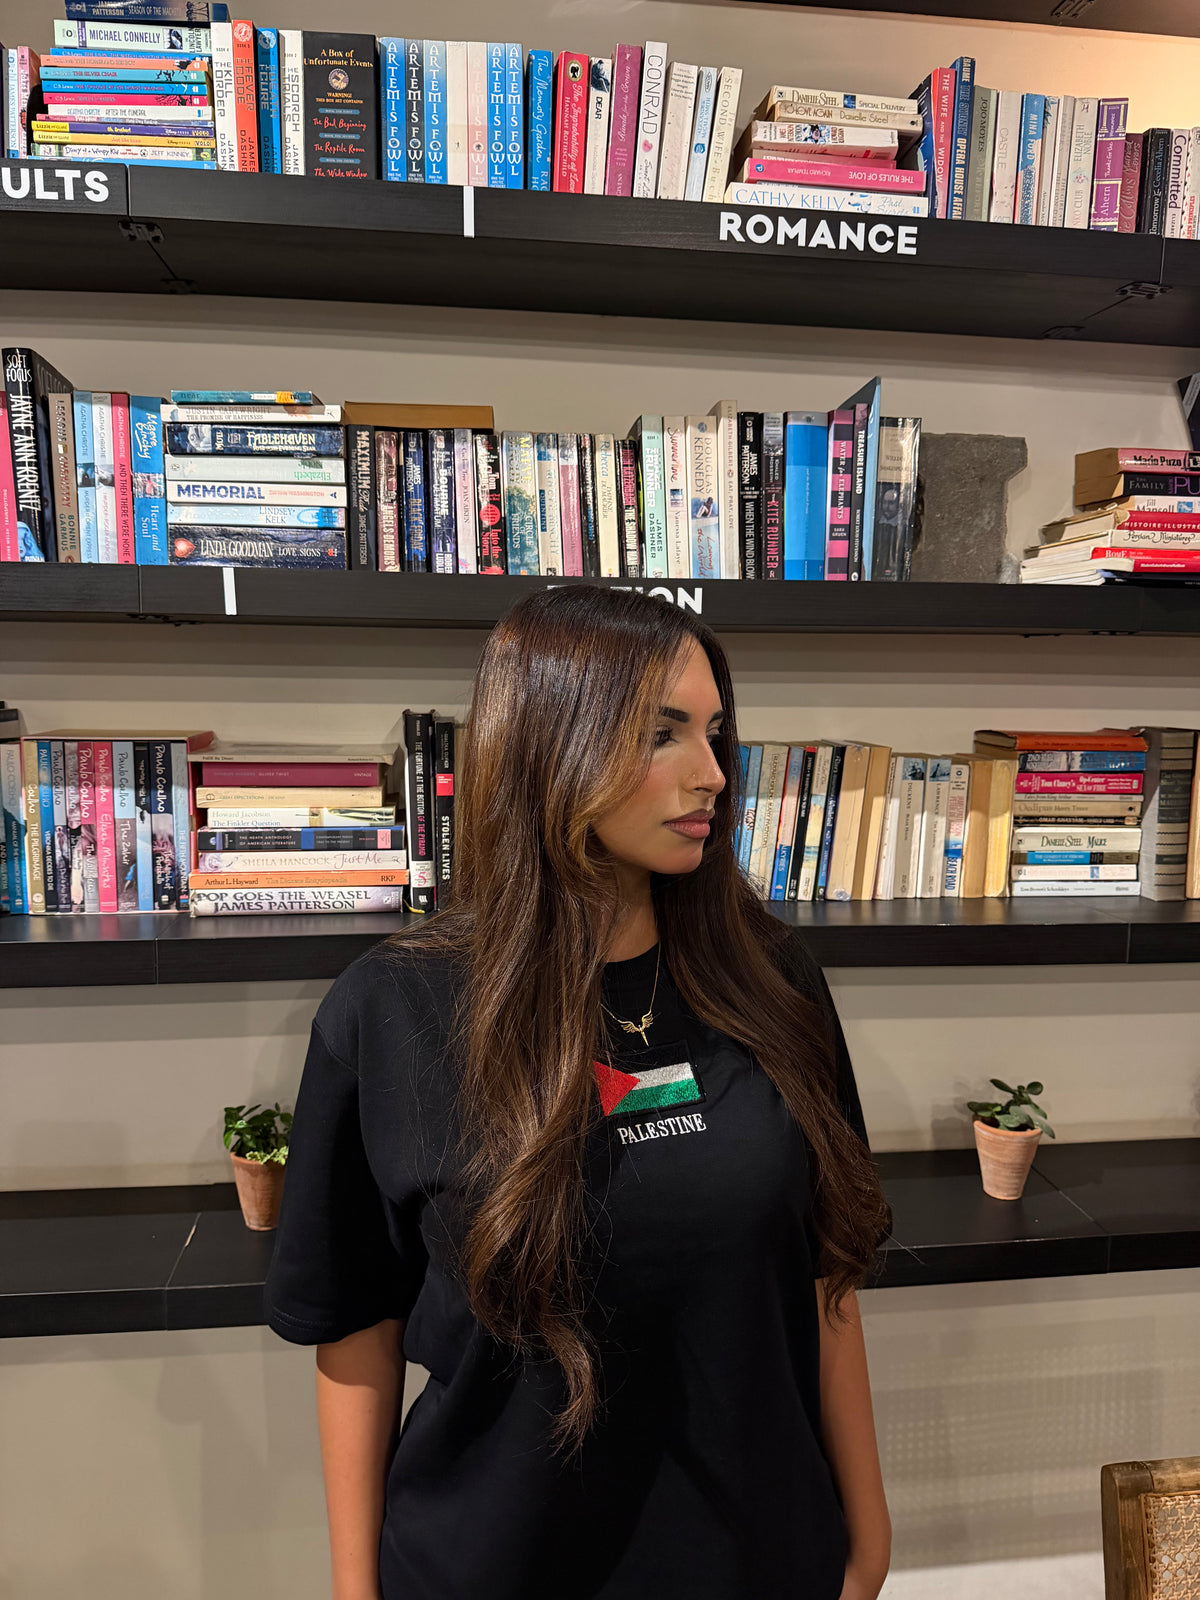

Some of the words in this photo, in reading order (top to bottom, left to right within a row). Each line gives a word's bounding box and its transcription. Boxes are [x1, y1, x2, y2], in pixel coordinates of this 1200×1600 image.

[89, 30, 122, 41] MICHAEL
[124, 32, 160, 43] CONNELLY
[350, 59, 373, 68] Events
[215, 72, 225, 117] ORDER
[224, 70, 233, 98] KILL
[236, 67, 245, 104] CODE
[245, 66, 254, 111] FEVER
[260, 72, 268, 110] CURE
[269, 73, 277, 118] DEATH
[387, 42, 400, 122] ARTEMIS
[408, 43, 421, 123] ARTEMIS
[428, 44, 441, 125] ARTEMIS
[491, 47, 504, 126] ARTEMIS
[508, 47, 521, 126] ARTEMIS
[642, 55, 663, 135] CONRAD
[942, 74, 950, 90] THE
[283, 75, 291, 122] TRIALS
[291, 75, 299, 132] SCORCH
[595, 96, 603, 119] DEAR
[718, 78, 732, 126] SECOND
[940, 94, 948, 117] WIFE
[980, 97, 988, 118] JOJO
[323, 117, 336, 128] Bad
[338, 120, 366, 131] Beginning
[840, 111, 867, 122] Danielle
[869, 113, 888, 124] Steel
[1028, 113, 1038, 136] MINA
[325, 142, 346, 153] Reptile
[348, 144, 365, 152] Room
[387, 126, 401, 171] FOWL
[408, 127, 423, 172] FOWL
[713, 131, 725, 157] WIFE
[978, 120, 986, 152] MOYES
[998, 128, 1008, 169] CASTLE
[1026, 140, 1035, 160] FORD
[1074, 125, 1084, 161] ELIZABETH
[1083, 131, 1092, 154] NOBLE
[1155, 138, 1164, 159] Ahern
[428, 129, 443, 174] FOWL
[490, 131, 505, 175] FOWL
[507, 131, 522, 175] FOWL
[937, 147, 945, 183] WIDOW
[1, 167, 109, 202] ULTS
[849, 171, 866, 179] LOVE
[879, 173, 899, 182] RULES
[901, 175, 914, 183] THE
[1153, 160, 1161, 187] Cecelia
[1169, 135, 1187, 209] Committed
[736, 189, 795, 207] CATHY
[801, 194, 845, 211] KELLY
[1101, 186, 1111, 216] Ahern
[719, 211, 918, 255] ROMANCE
[6, 354, 27, 368] SOFT
[6, 369, 32, 383] FOCUS
[9, 394, 34, 429] JAYNE
[14, 433, 37, 462] ANN
[247, 432, 316, 446] FABLEHAVEN
[857, 430, 865, 468] TREASURE
[119, 463, 127, 478] AND
[357, 431, 370, 489] MAXIMUM
[600, 440, 612, 477] Rebecca
[694, 437, 704, 494] KENNEDY
[704, 437, 713, 494] DOUGLAS
[741, 445, 750, 484] PATTERSON
[749, 452, 758, 475] JAMES
[1133, 456, 1159, 465] Mario
[1160, 456, 1181, 467] Puzo
[18, 466, 41, 512] KRENTZ
[120, 480, 128, 496] THEN
[406, 457, 415, 492] PATTERSON
[646, 454, 656, 507] RUNNER
[1129, 480, 1165, 490] FAMILY
[177, 484, 265, 500] MEMORIAL
[358, 489, 370, 513] Ride
[433, 484, 441, 528] ULTIMATUM
[440, 469, 449, 515] BOURNE
[120, 498, 128, 518] THERE
[151, 505, 159, 530] Heart
[259, 506, 292, 515] LINDSEY
[265, 515, 287, 524] KELK
[382, 505, 395, 532] ANGELS
[767, 501, 778, 524] KITE
[59, 513, 67, 551] GARMUS
[68, 515, 76, 550] BONNIE
[142, 517, 150, 538] Soul
[491, 528, 501, 544] Into
[511, 513, 520, 549] FRIENDS
[526, 515, 534, 545] CIRCLE
[122, 538, 130, 557] NONE
[152, 535, 160, 551] and
[200, 540, 228, 556] LINDA
[229, 540, 273, 557] GOODMAN
[278, 547, 297, 556] LOVE
[300, 548, 321, 557] SIGNS
[359, 533, 367, 564] PATTERSON
[383, 534, 396, 565] DEMONS
[481, 532, 490, 556] Storm
[492, 546, 502, 558] the
[767, 527, 778, 569] RUNNER
[79, 748, 90, 778] Paulo
[118, 752, 128, 774] Paulo
[154, 744, 166, 774] Paulo
[81, 781, 93, 818] Coelho
[119, 777, 129, 808] Coelho
[157, 777, 167, 812] Coelho
[31, 822, 39, 837] THE
[121, 821, 130, 840] The
[251, 820, 281, 828] Question
[441, 816, 449, 850] STOLEN
[32, 838, 42, 881] PILGRIMAGE
[121, 841, 131, 866] Zahir
[442, 853, 450, 880] LIVES
[197, 892, 229, 901] POP
[233, 891, 274, 901] GOES
[278, 891, 306, 901] THE
[310, 891, 371, 901] WEASEL
[226, 878, 231, 886] L.
[232, 878, 259, 886] Hayward
[214, 902, 264, 912] JAMES
[270, 901, 355, 911] PATTERSON
[617, 1113, 706, 1144] PALESTINE
